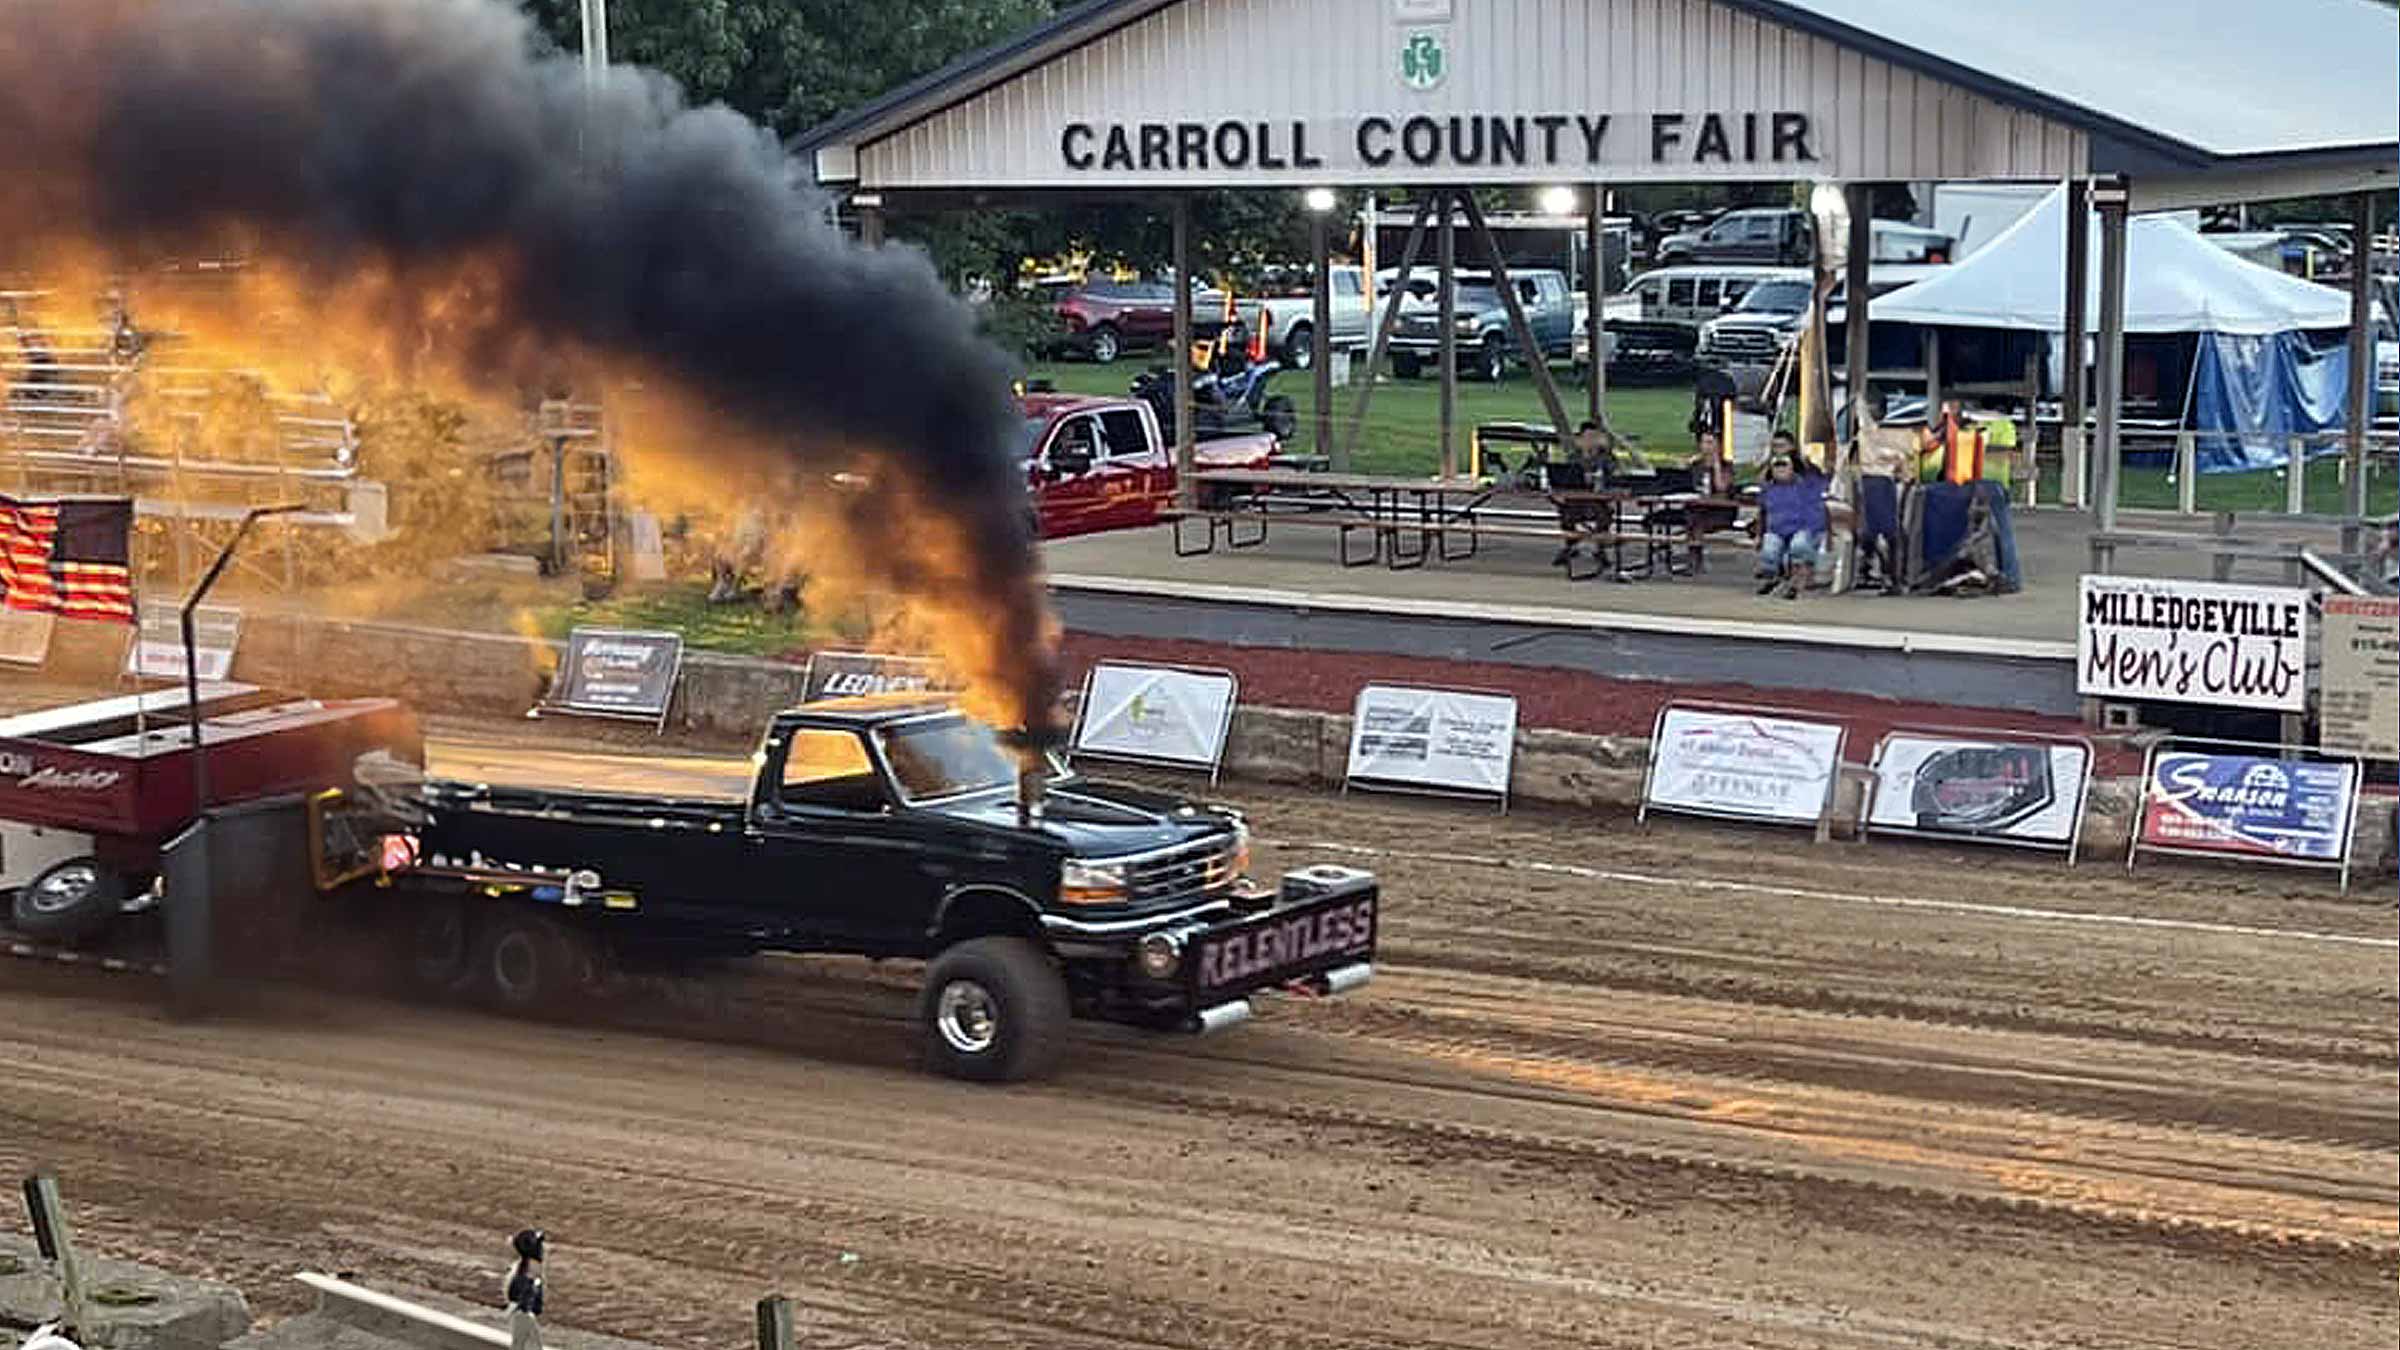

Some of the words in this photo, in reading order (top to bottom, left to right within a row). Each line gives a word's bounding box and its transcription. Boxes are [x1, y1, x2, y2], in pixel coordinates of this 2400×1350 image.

[1061, 121, 1322, 170] CARROLL
[1356, 114, 1612, 168] COUNTY
[1650, 111, 1819, 164] FAIR
[2086, 591, 2299, 638] MILLEDGEVILLE
[2087, 629, 2198, 695] Men's
[2202, 636, 2300, 698] Club
[1199, 901, 1372, 968] RELENTLESS
